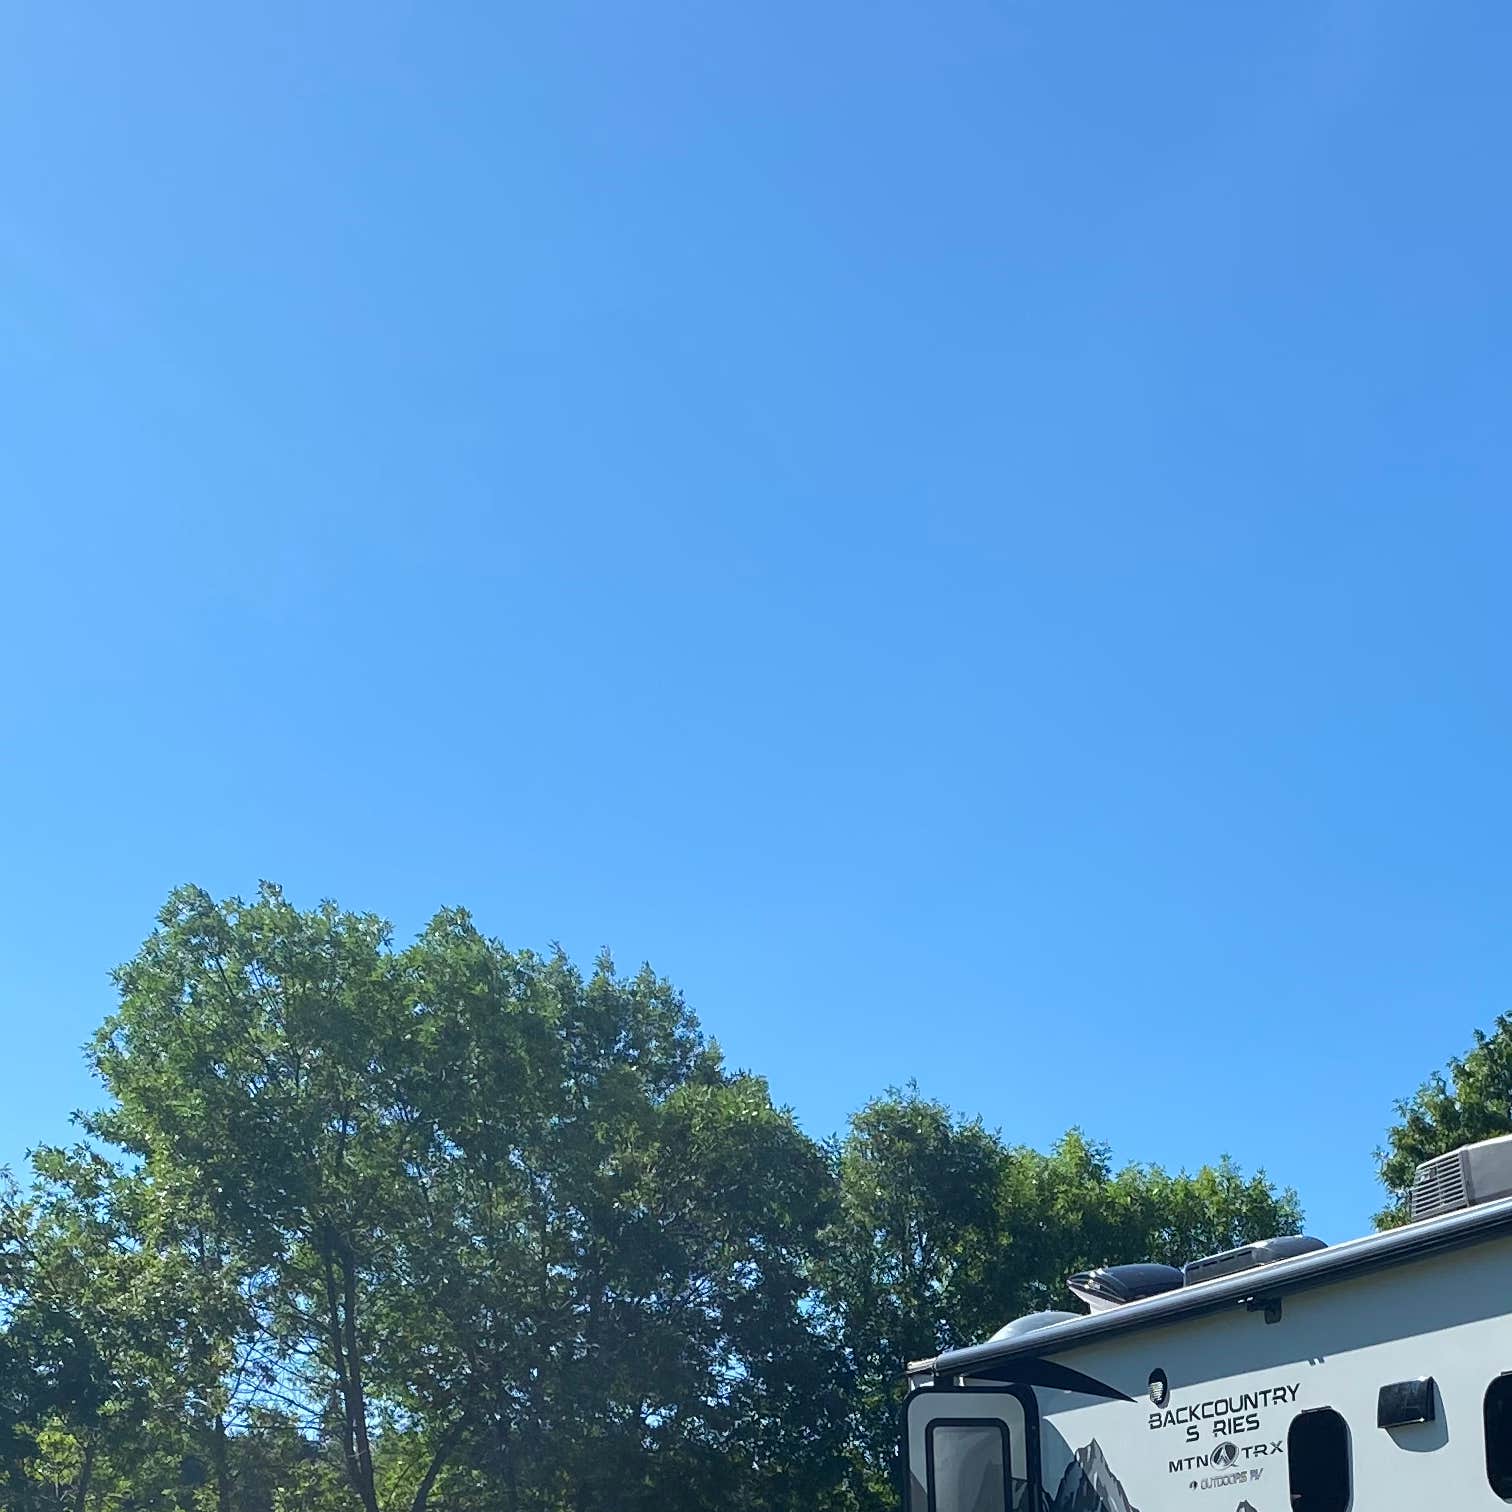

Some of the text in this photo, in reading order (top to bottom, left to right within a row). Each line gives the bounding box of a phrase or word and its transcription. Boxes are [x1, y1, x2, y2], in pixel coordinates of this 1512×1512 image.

[1148, 1382, 1301, 1430] BACKCOUNTRY
[1186, 1412, 1260, 1444] SRIES
[1168, 1440, 1284, 1473] MTN TRX
